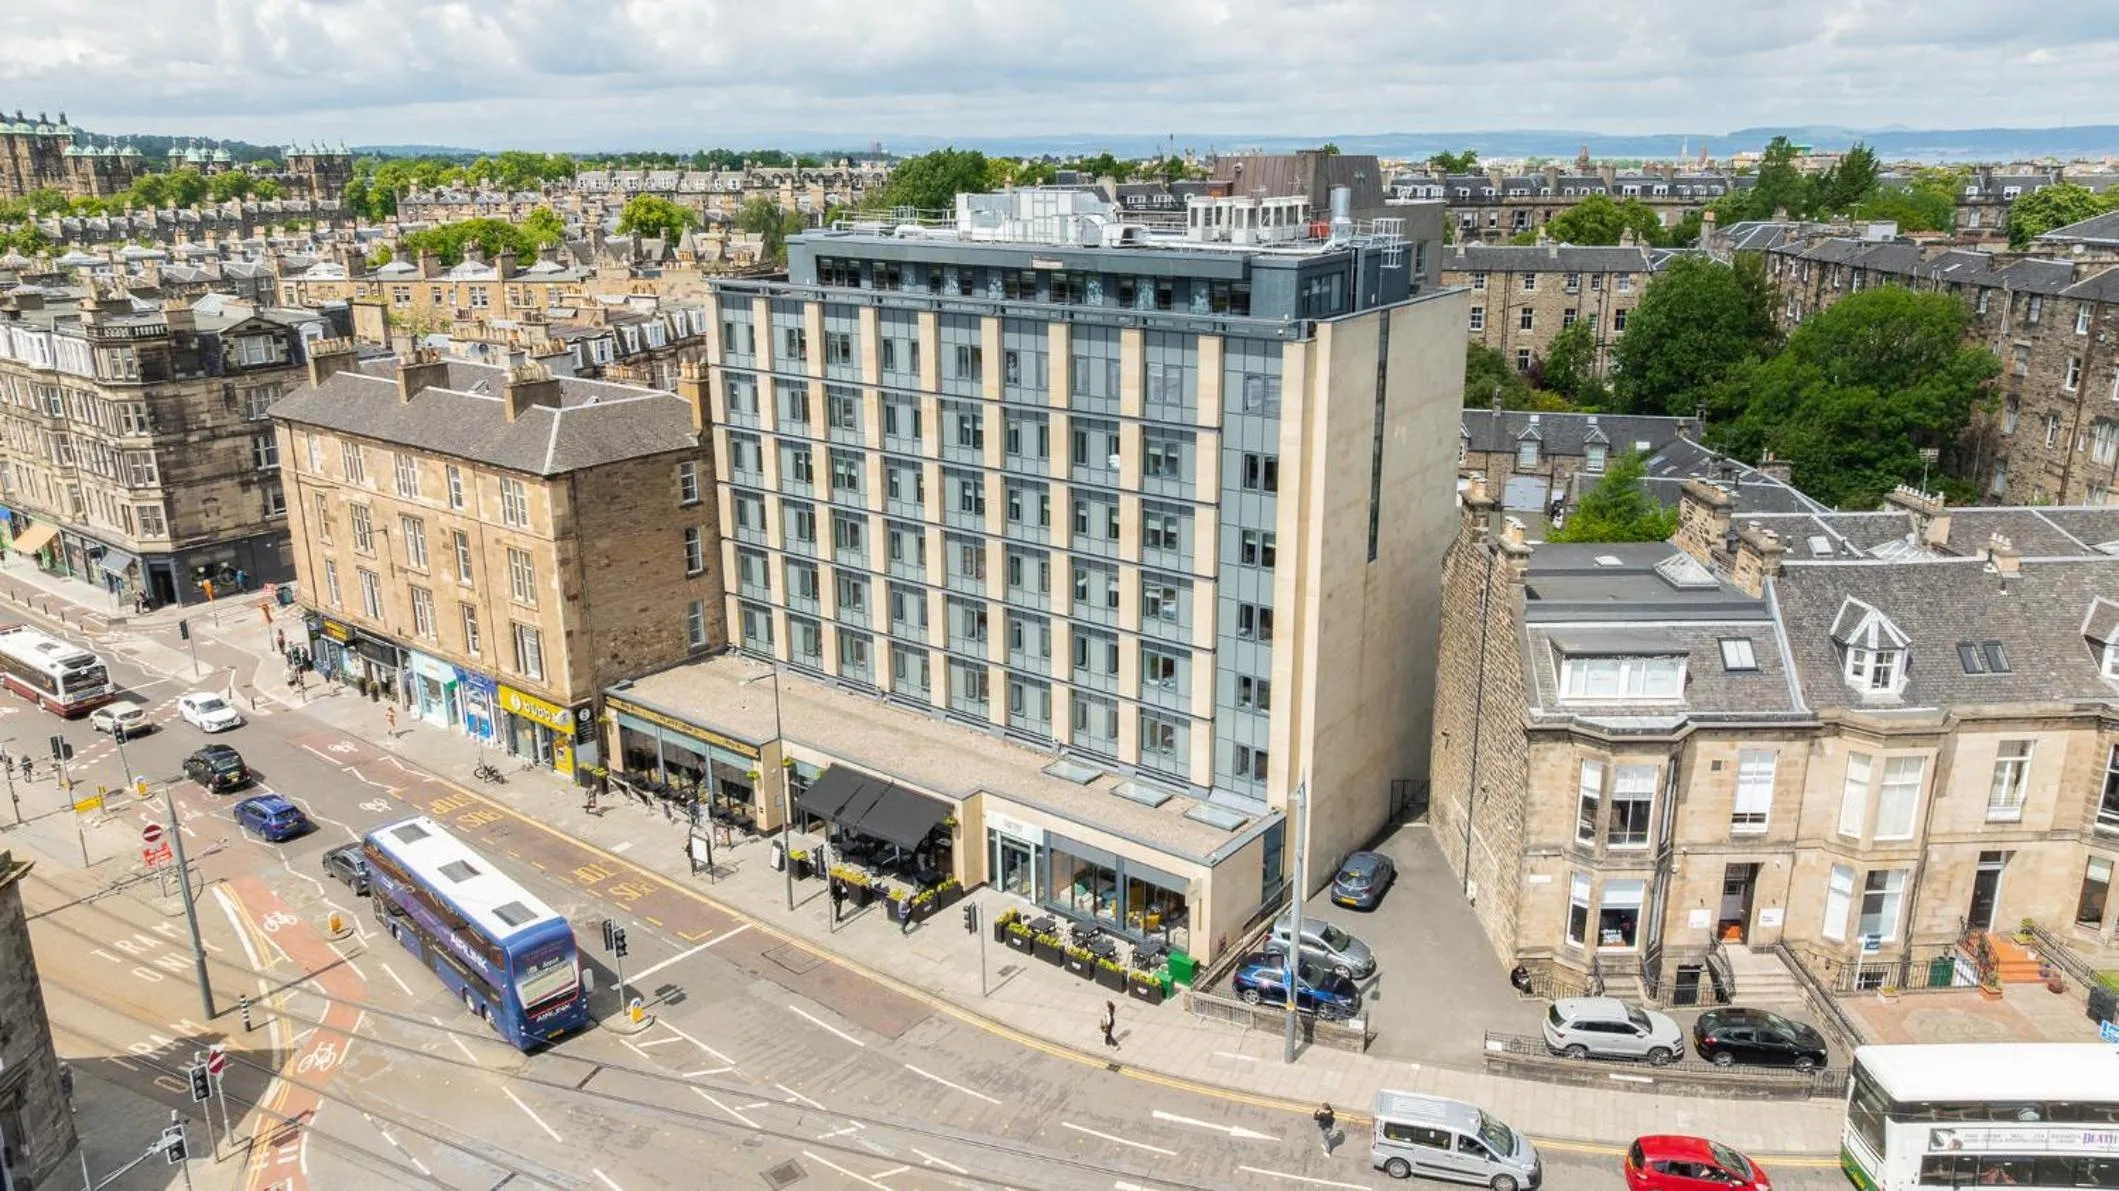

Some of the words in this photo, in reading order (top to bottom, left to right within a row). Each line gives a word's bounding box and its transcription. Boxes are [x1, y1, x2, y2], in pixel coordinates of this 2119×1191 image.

[89, 921, 188, 964] TRAM
[536, 1003, 572, 1023] AIRLINK
[102, 1018, 213, 1072] TRAM
